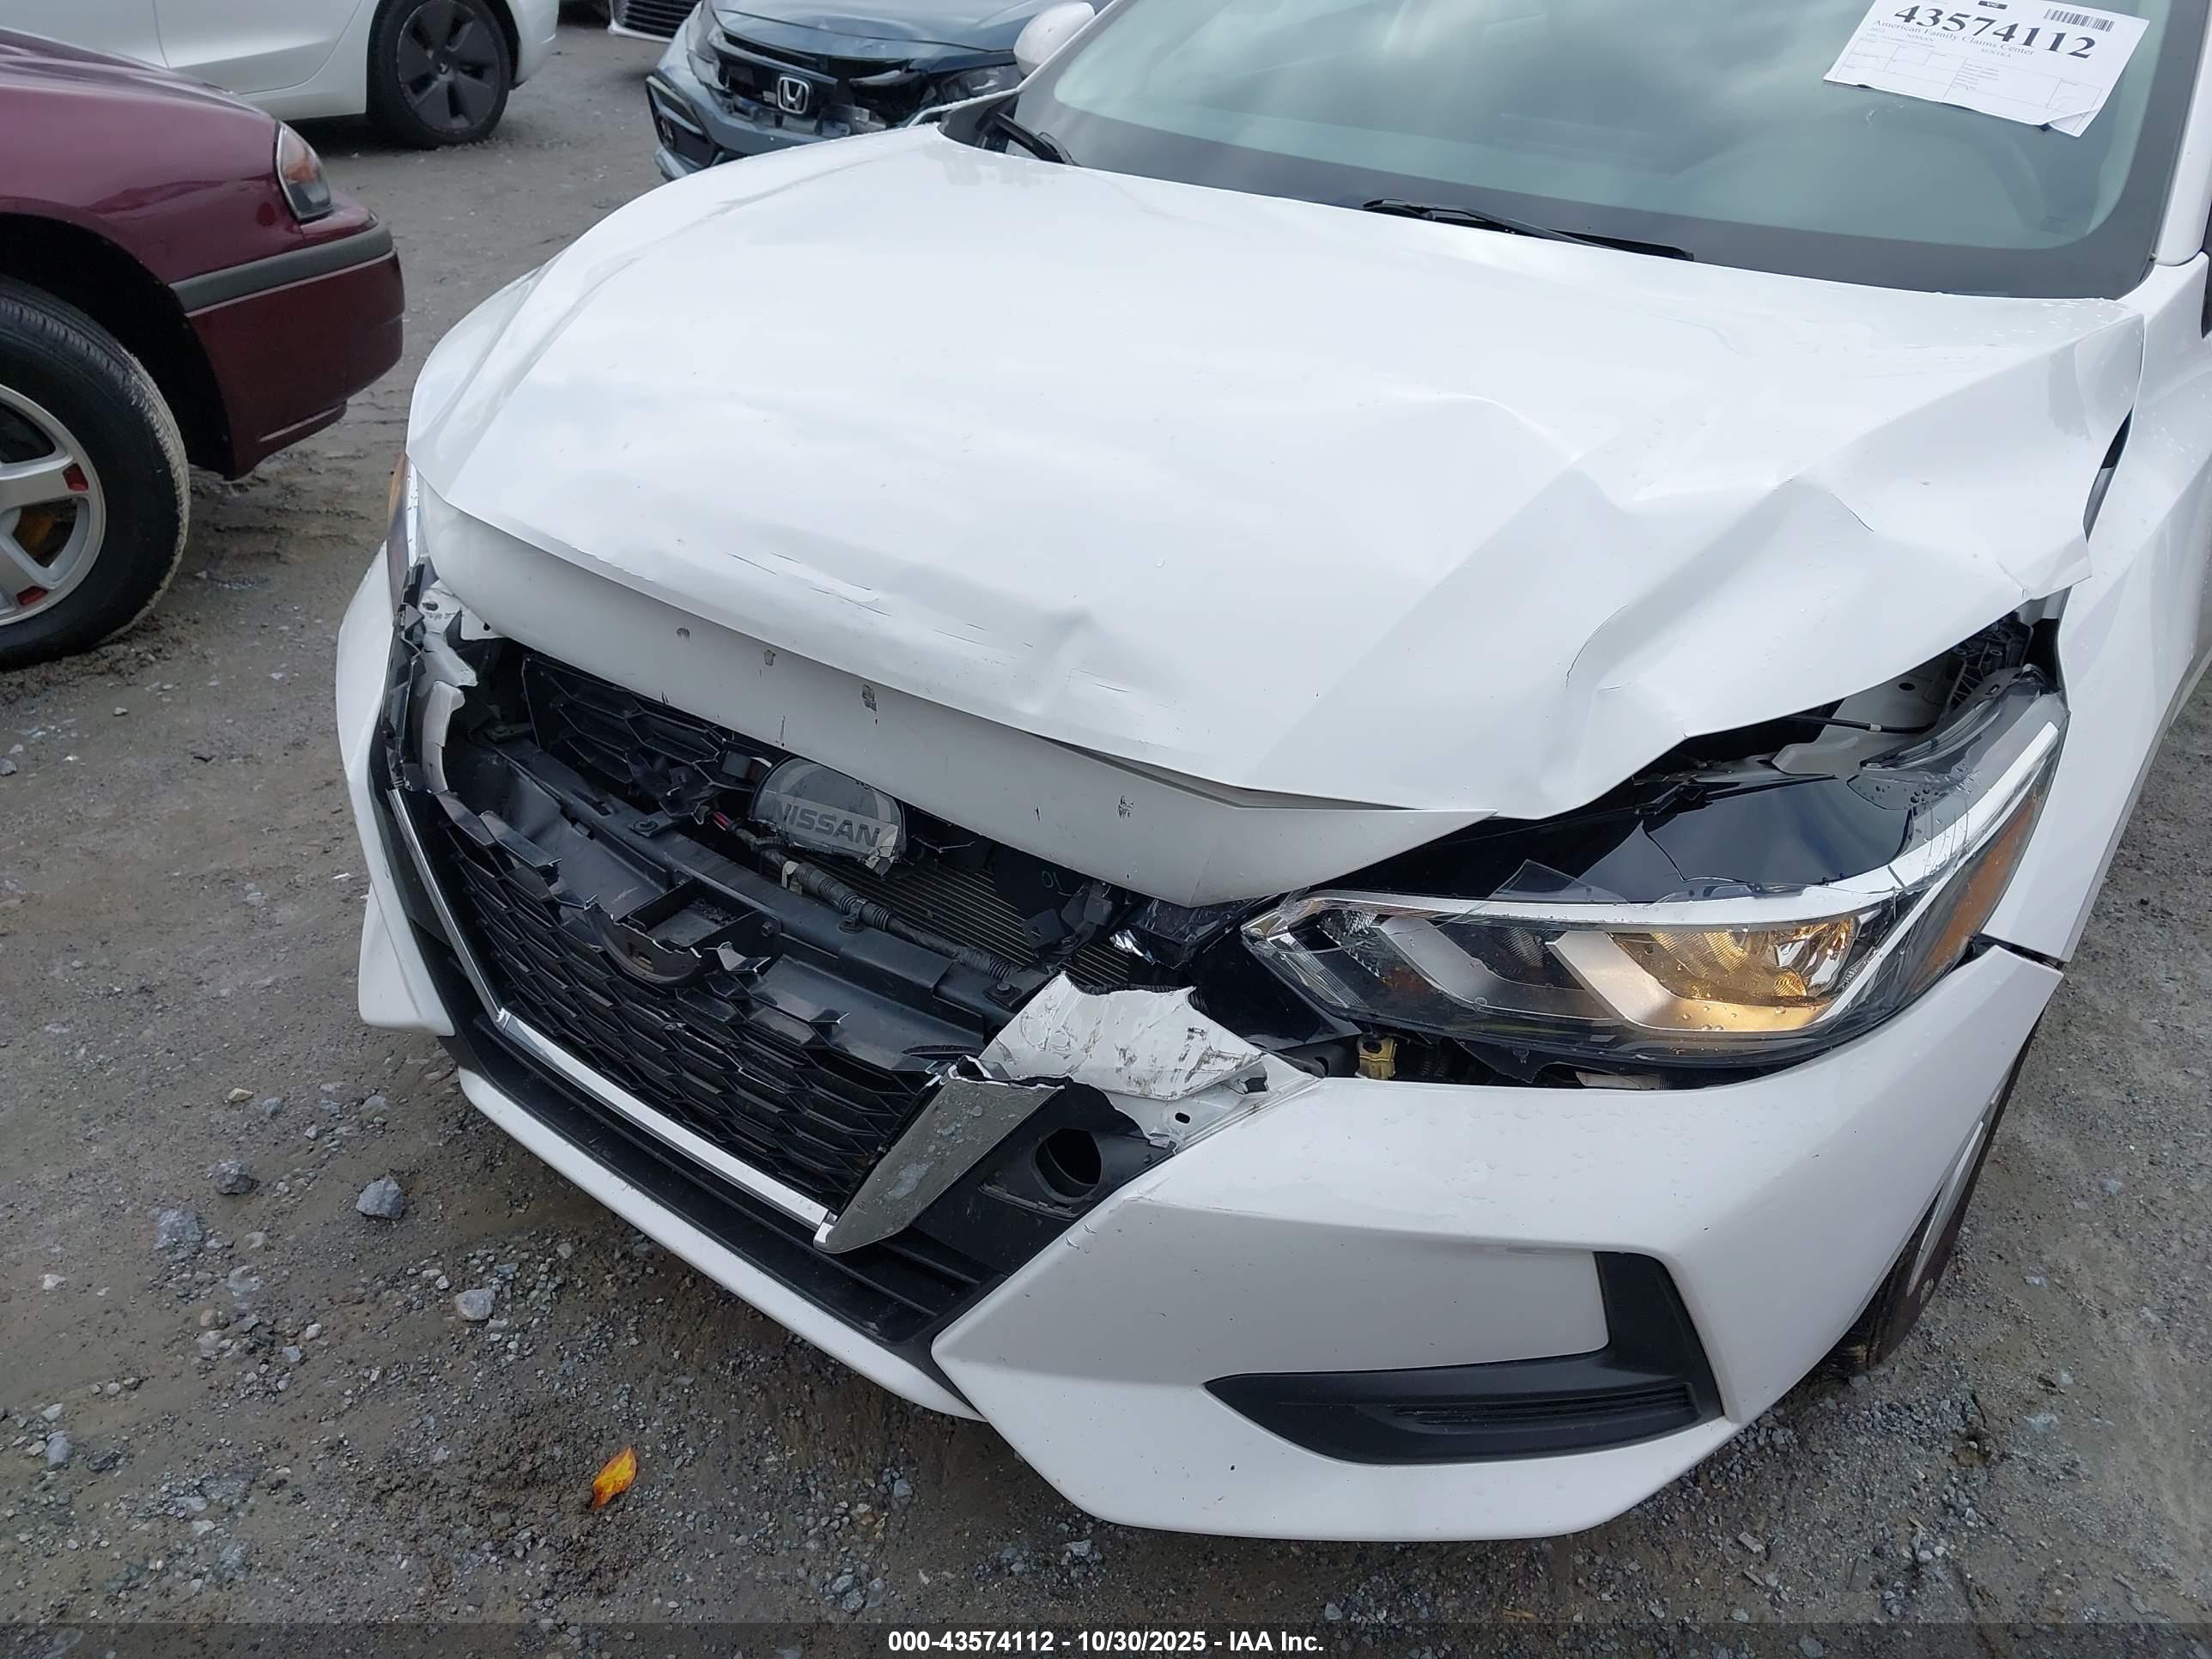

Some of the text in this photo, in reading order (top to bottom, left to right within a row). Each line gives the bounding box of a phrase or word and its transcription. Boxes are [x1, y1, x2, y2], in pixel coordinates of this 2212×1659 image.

[1875, 20, 1921, 33] American
[1923, 28, 1957, 41] Family
[1961, 35, 1997, 49] Claims
[2000, 41, 2034, 55] Center
[1894, 5, 2096, 58] 43574112
[769, 799, 881, 848] NISSAN
